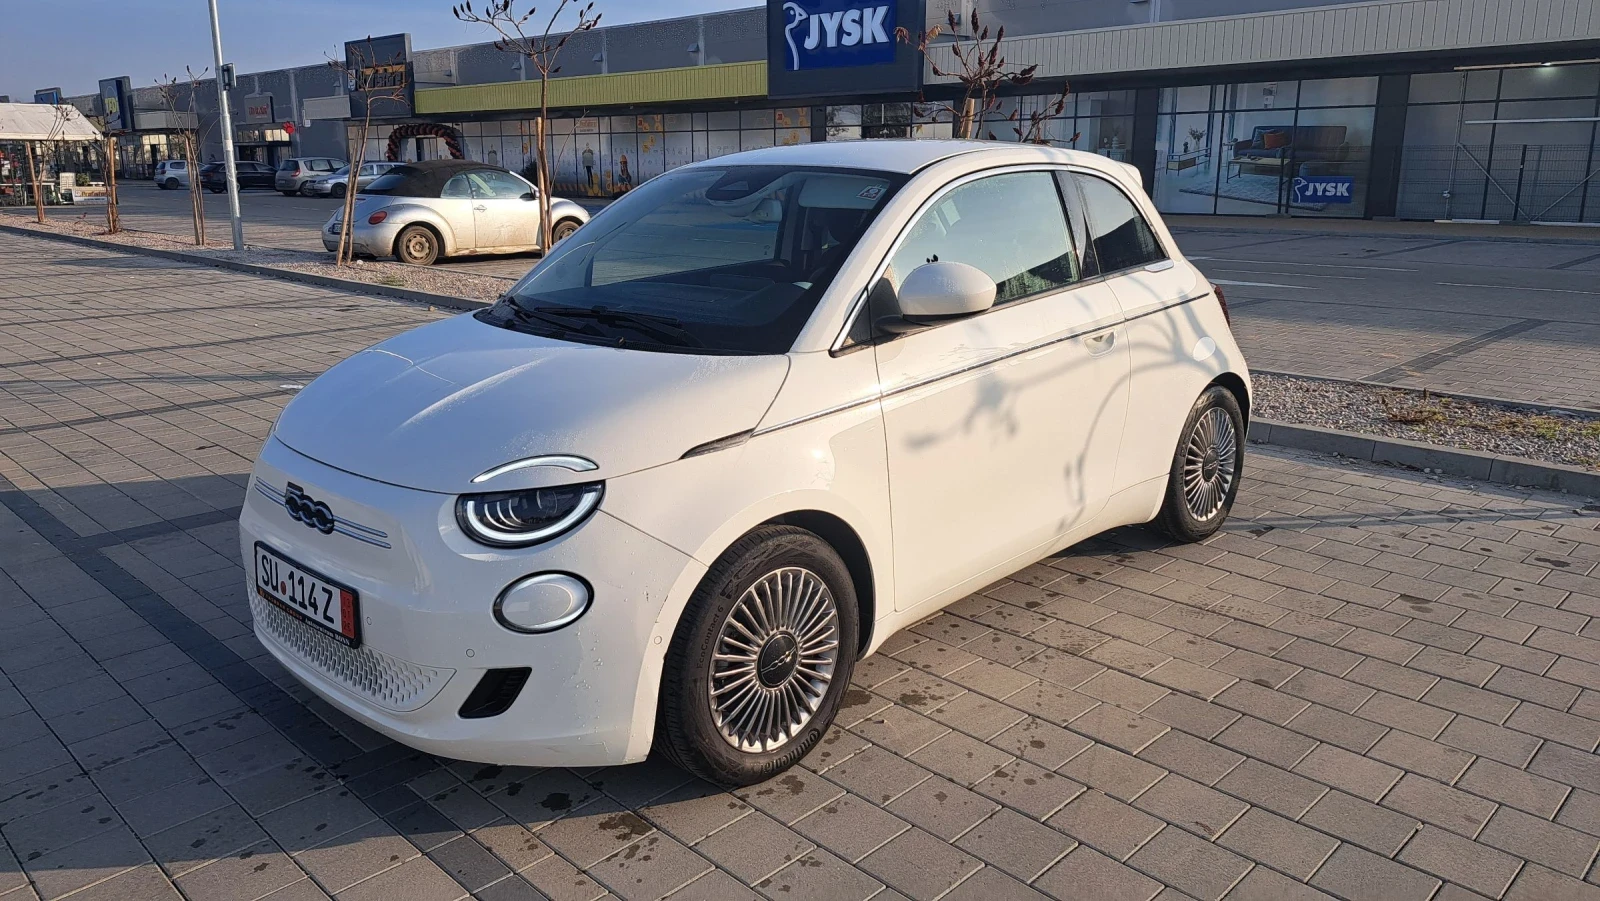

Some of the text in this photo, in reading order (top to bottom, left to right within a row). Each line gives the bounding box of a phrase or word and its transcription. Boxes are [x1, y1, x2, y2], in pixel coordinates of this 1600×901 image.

[804, 6, 890, 50] JYSK
[1304, 182, 1351, 197] JYSK
[285, 481, 335, 535] 500
[696, 604, 724, 669] EcoContact 6
